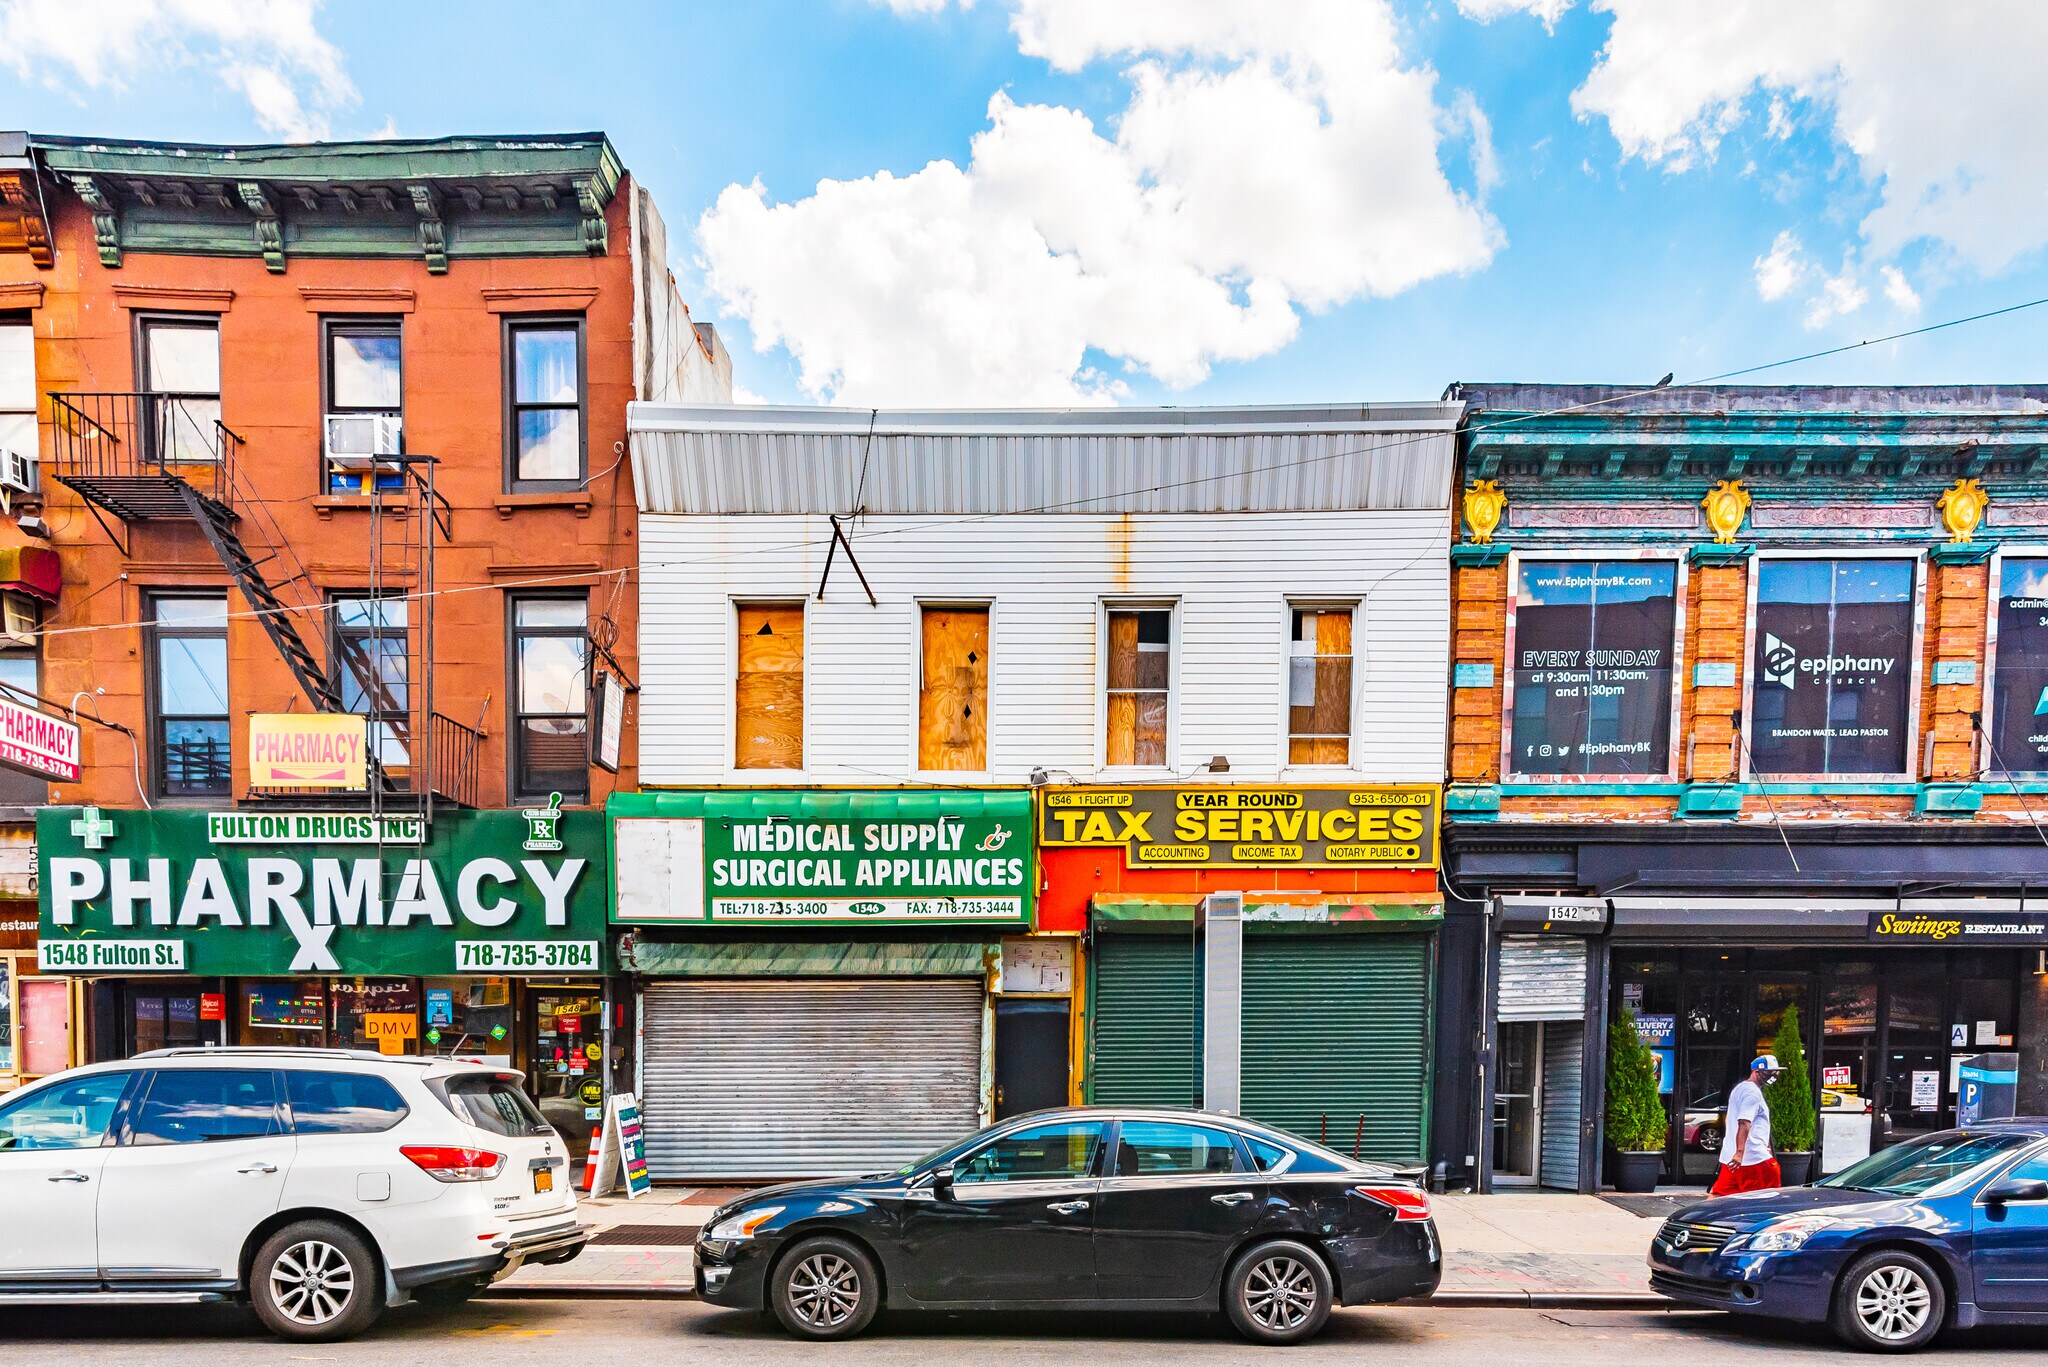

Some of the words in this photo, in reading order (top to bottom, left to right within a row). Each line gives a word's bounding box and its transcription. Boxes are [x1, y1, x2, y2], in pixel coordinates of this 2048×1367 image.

[1537, 576, 1651, 588] www.EpiphanyBK.com
[1523, 651, 1580, 667] EVERY
[1585, 650, 1660, 666] SUNDAY
[1800, 654, 1895, 675] epiphany
[1532, 672, 1544, 683] at
[1596, 670, 1649, 682] 11:30am,
[1556, 686, 1579, 697] and
[1583, 685, 1625, 698] 1:30pm
[255, 732, 360, 763] PHARMACY
[1578, 742, 1651, 755] #EpiphanyBK
[2, 743, 73, 778] 718-735-3784
[1051, 794, 1072, 806] 1546
[1079, 794, 1083, 805] 1
[1085, 794, 1115, 806] FLIGHT
[1117, 794, 1129, 805] UP
[1182, 794, 1228, 807] YEAR
[1238, 793, 1298, 807] ROUND
[1354, 793, 1427, 805] 953-6500-01
[211, 816, 289, 838] FULTON
[296, 816, 372, 838] DRUGS
[1054, 811, 1154, 841] TAX
[1174, 809, 1424, 841] SERVICES
[733, 824, 855, 851] MEDICAL
[864, 823, 966, 850] SUPPLY
[1143, 846, 1205, 858] ACCOUNTING
[1238, 846, 1275, 858] INCOME
[1280, 846, 1297, 858] TAX
[1330, 847, 1366, 858] NOTARY
[1370, 846, 1404, 858] PUBLIC
[712, 858, 846, 886] SURGICAL
[854, 858, 1023, 885] APPLIANCES
[50, 857, 587, 927] PHARMACY
[853, 904, 880, 914] 1546
[906, 902, 933, 914] FAX:
[936, 901, 1015, 914] 718-735-3444
[1551, 907, 1578, 919] 1542
[0, 920, 39, 930] estaur
[1875, 914, 1961, 940] Swiingz
[1964, 925, 2045, 935] RESTAURANT
[44, 944, 87, 965] 1548
[93, 943, 151, 965] Fulton
[155, 943, 179, 965] St.
[461, 944, 593, 967] 718-735-3784
[556, 1004, 580, 1014] 1548
[369, 1022, 411, 1034] DMV
[1952, 1027, 1964, 1040] A
[1825, 1075, 1849, 1086] OPEN
[1967, 1083, 1977, 1103] P
